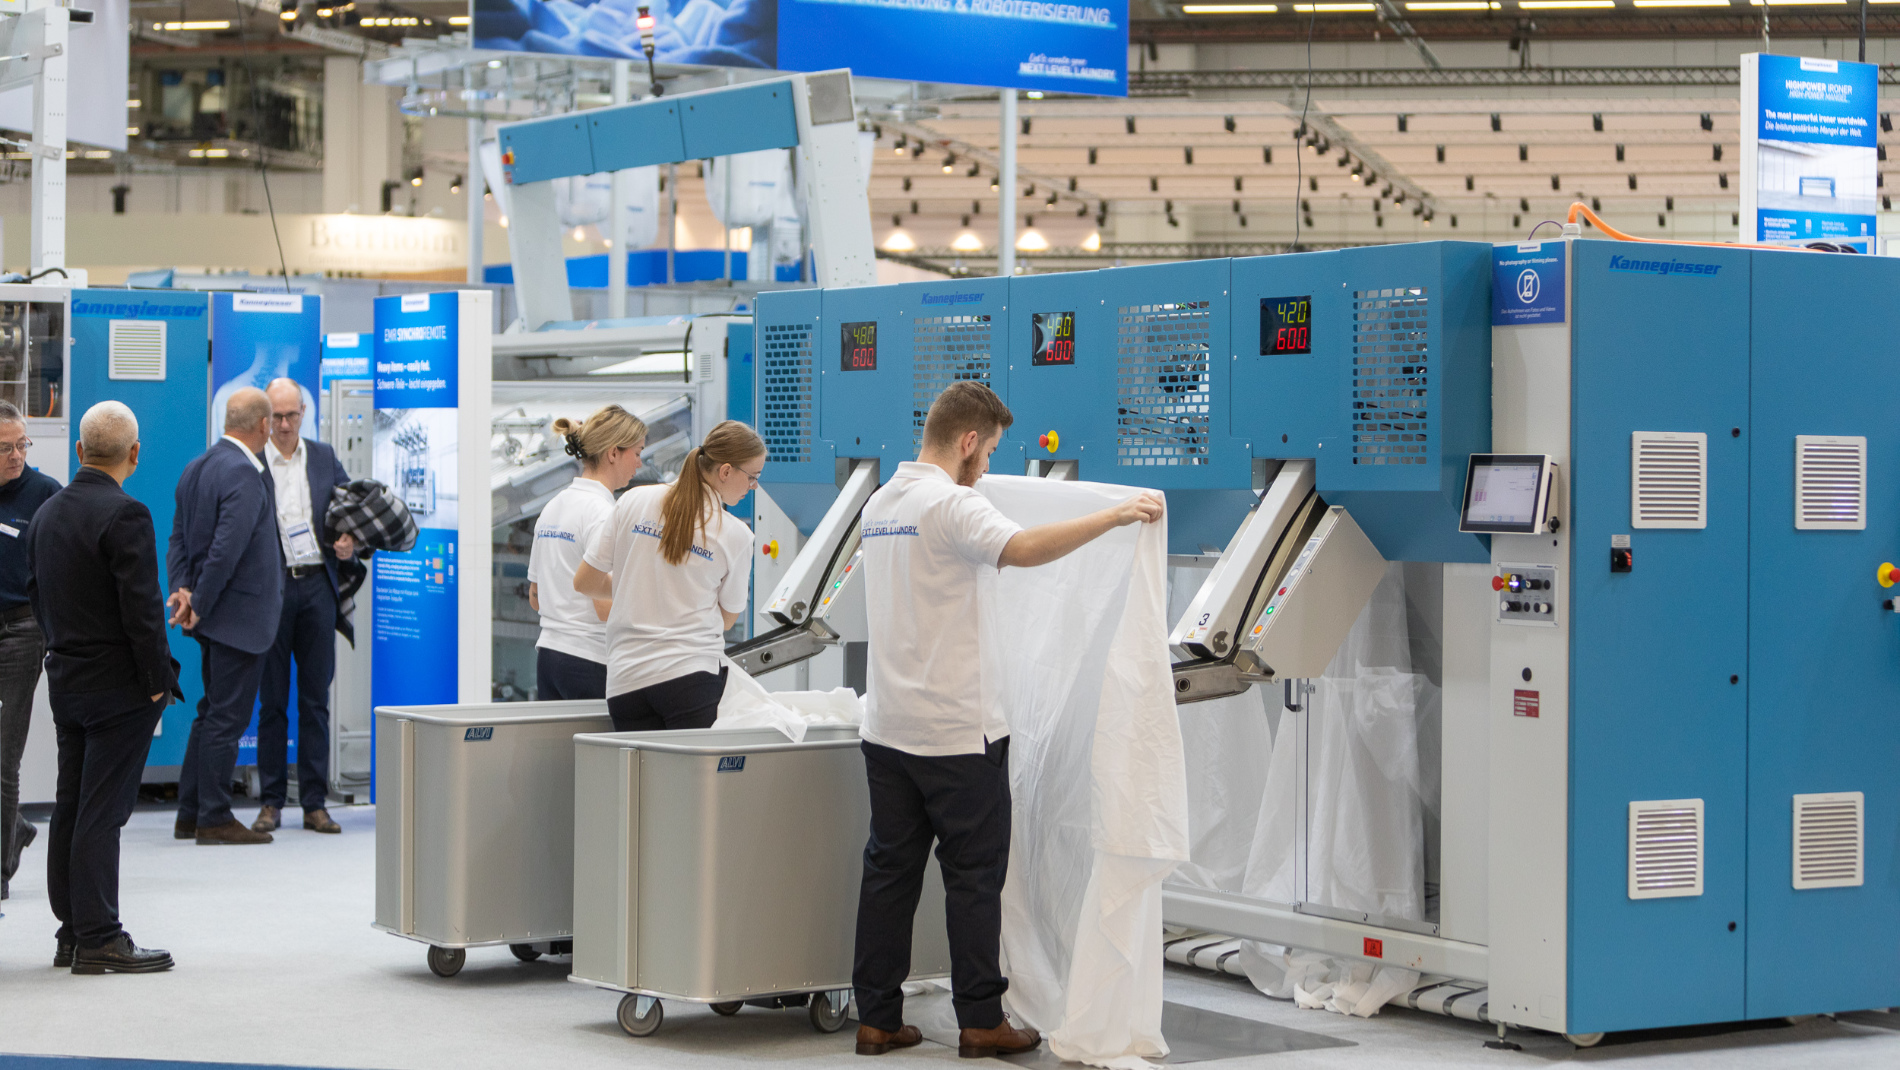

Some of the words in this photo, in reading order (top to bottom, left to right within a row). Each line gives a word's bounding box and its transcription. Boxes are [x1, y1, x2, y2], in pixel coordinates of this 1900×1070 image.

[971, 0, 1111, 24] ROBOTERISIERUNG
[1020, 62, 1045, 74] NEXT
[1045, 64, 1073, 75] LEVEL
[1074, 66, 1116, 79] LAUNDRY
[1785, 79, 1826, 92] HIGHPOWER
[1828, 83, 1852, 95] IRONER
[1765, 109, 1776, 119] The
[1777, 111, 1792, 121] most
[1793, 112, 1818, 122] powerful
[1819, 113, 1836, 124] ironer
[1765, 120, 1774, 131] Die
[1820, 126, 1839, 137] Mangel
[1840, 127, 1849, 135] der
[1609, 255, 1722, 277] Kannegiesser
[921, 291, 985, 306] Kannegiesser
[1277, 301, 1307, 323] 420
[1047, 316, 1071, 337] 480
[853, 326, 874, 345] 480
[1277, 327, 1307, 350] 600
[853, 348, 874, 367] 600
[1046, 340, 1072, 361] 600
[544, 530, 558, 538] LEVE
[559, 531, 574, 541] NDRY
[634, 524, 652, 535] NEXT
[862, 528, 871, 537] EXT
[872, 527, 889, 536] LEVEL
[890, 525, 917, 535] LAUNDRY
[690, 544, 713, 558] NDRY
[1199, 613, 1210, 626] 3
